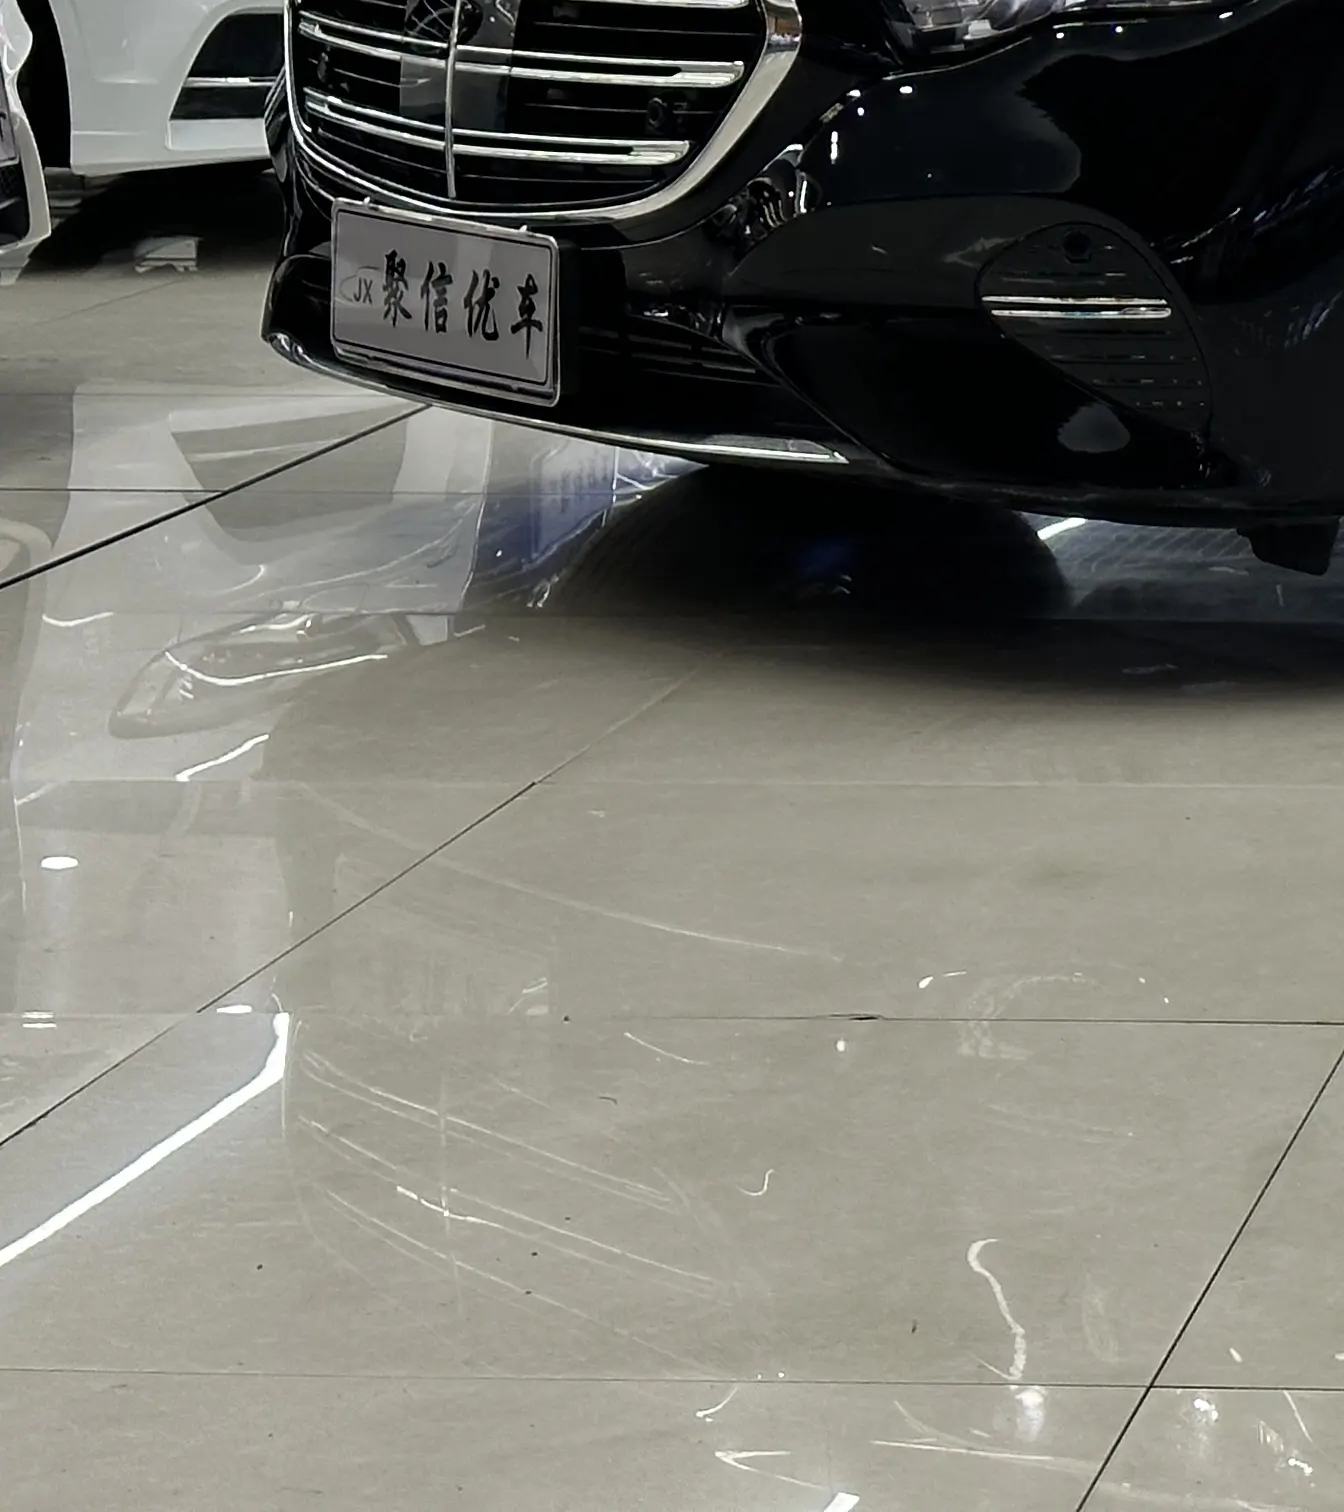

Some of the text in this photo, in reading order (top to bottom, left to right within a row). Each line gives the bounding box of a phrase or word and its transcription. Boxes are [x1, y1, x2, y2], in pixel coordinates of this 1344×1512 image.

[353, 248, 544, 360] JX 聚信优车
